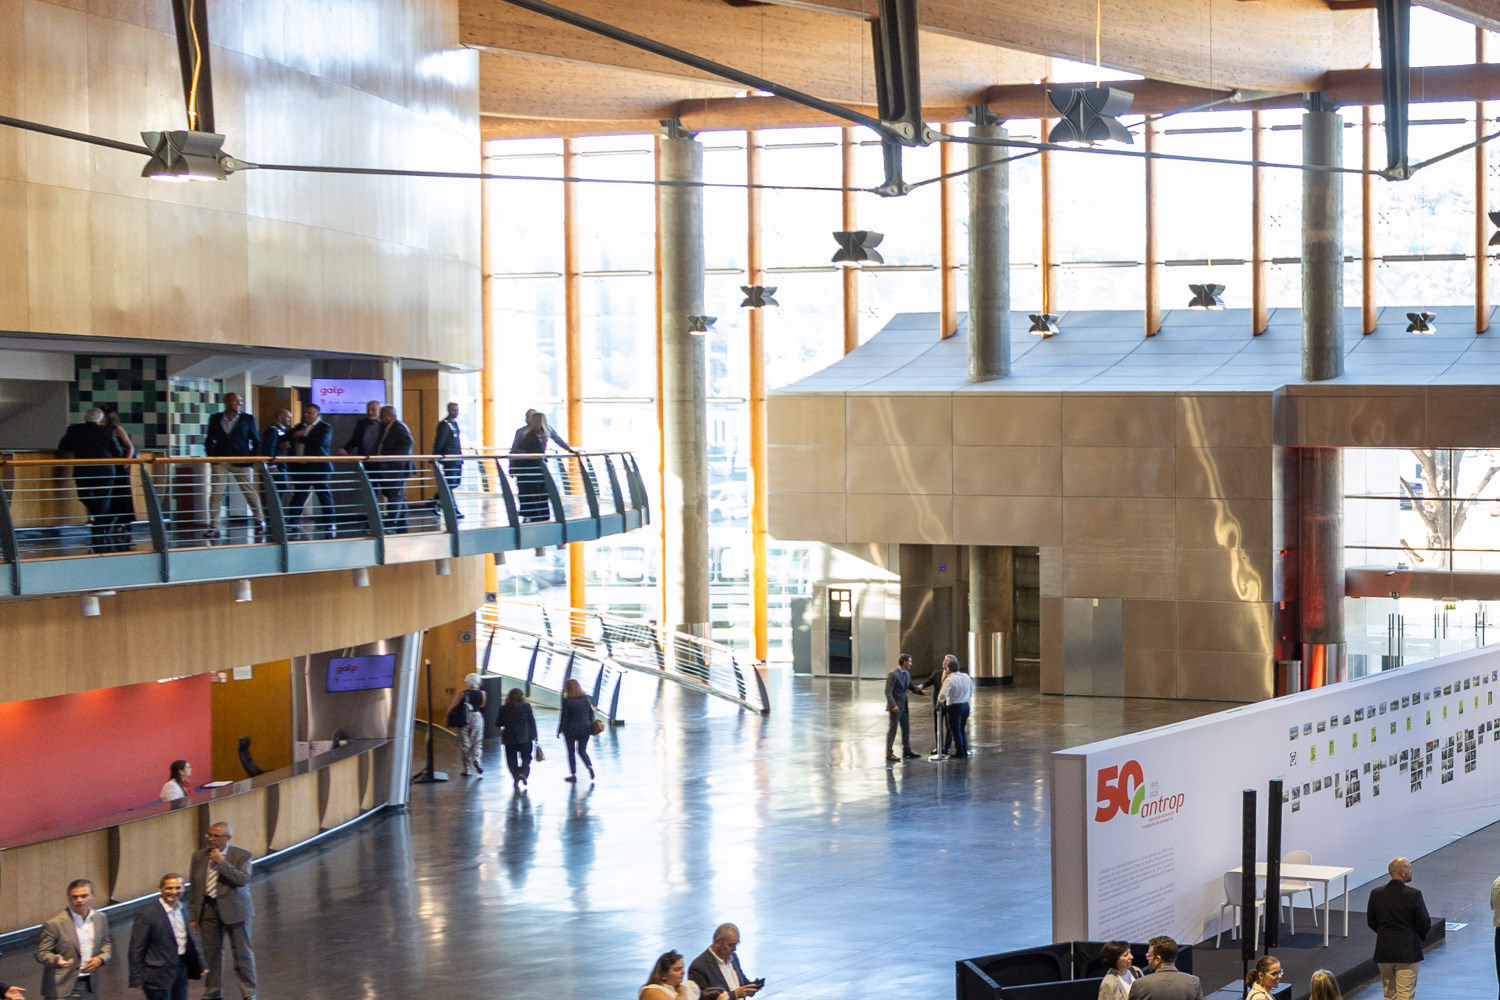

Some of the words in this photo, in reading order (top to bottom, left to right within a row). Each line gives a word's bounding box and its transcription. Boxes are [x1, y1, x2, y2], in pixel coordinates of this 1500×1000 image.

[320, 386, 344, 396] galp
[1095, 760, 1145, 822] 50
[1141, 793, 1184, 818] antrop
